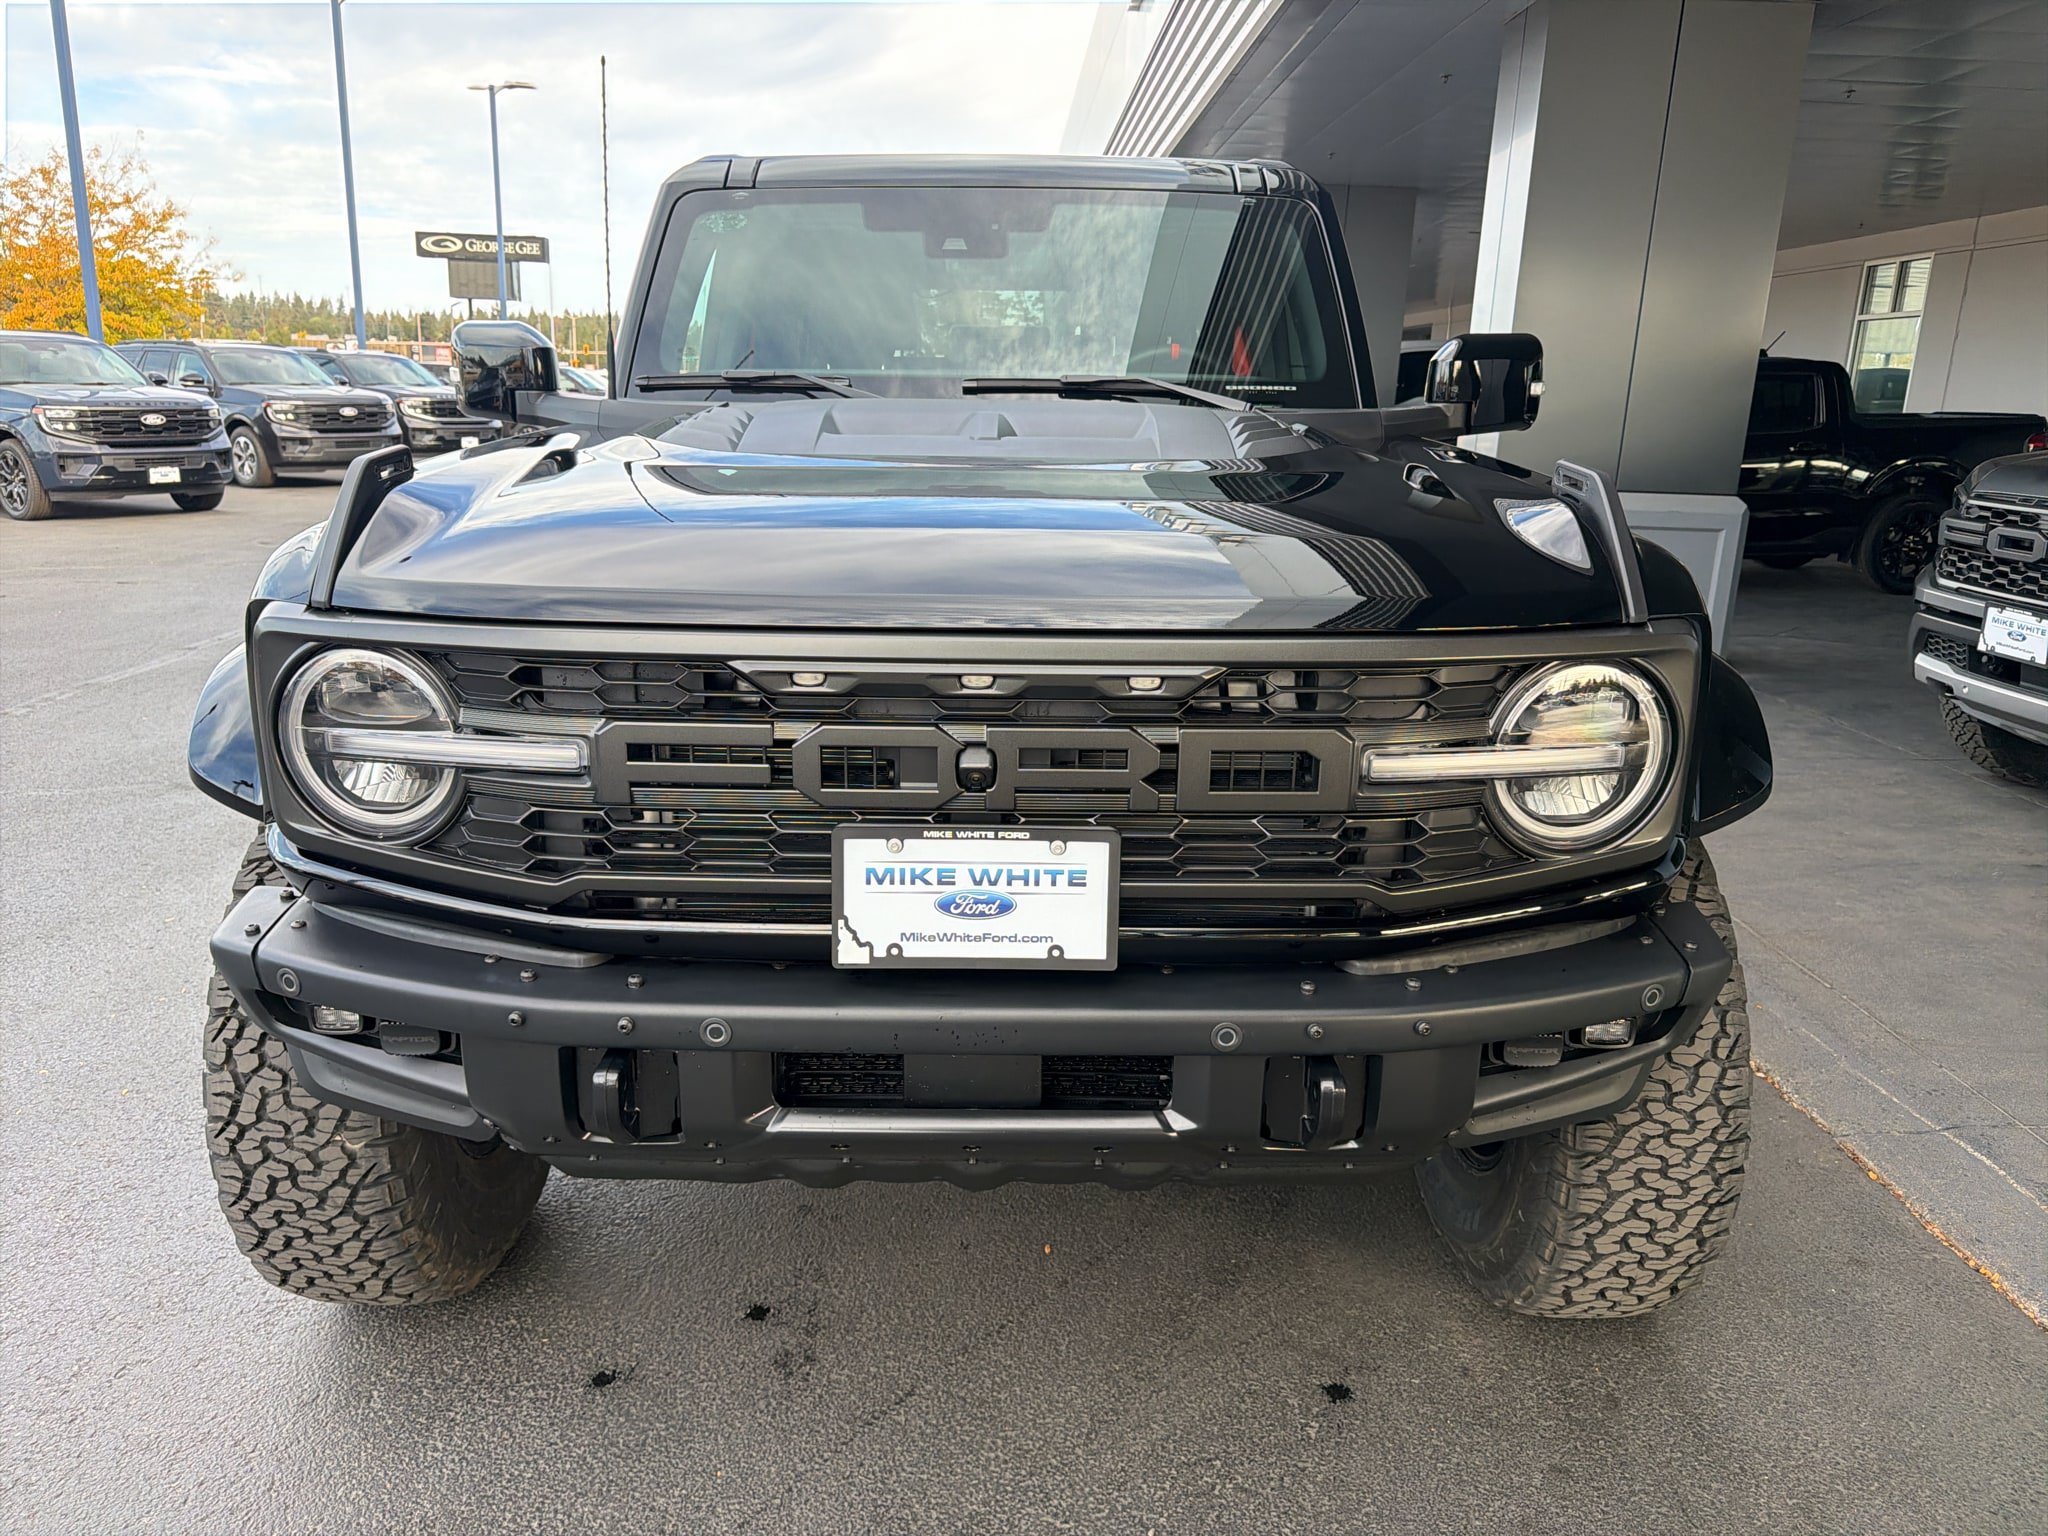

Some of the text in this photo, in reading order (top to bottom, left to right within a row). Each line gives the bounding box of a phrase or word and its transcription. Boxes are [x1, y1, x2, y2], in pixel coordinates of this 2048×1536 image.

[515, 241, 541, 255] GEE
[1991, 616, 2015, 628] MIKE
[2017, 622, 2048, 637] WHITE
[594, 720, 1354, 812] FORD
[923, 830, 1030, 840] MIKE WHITE FORD
[865, 867, 1088, 888] MIKE WHITE
[949, 894, 1001, 916] Ford
[900, 932, 1054, 944] MikeWhiteFord.com
